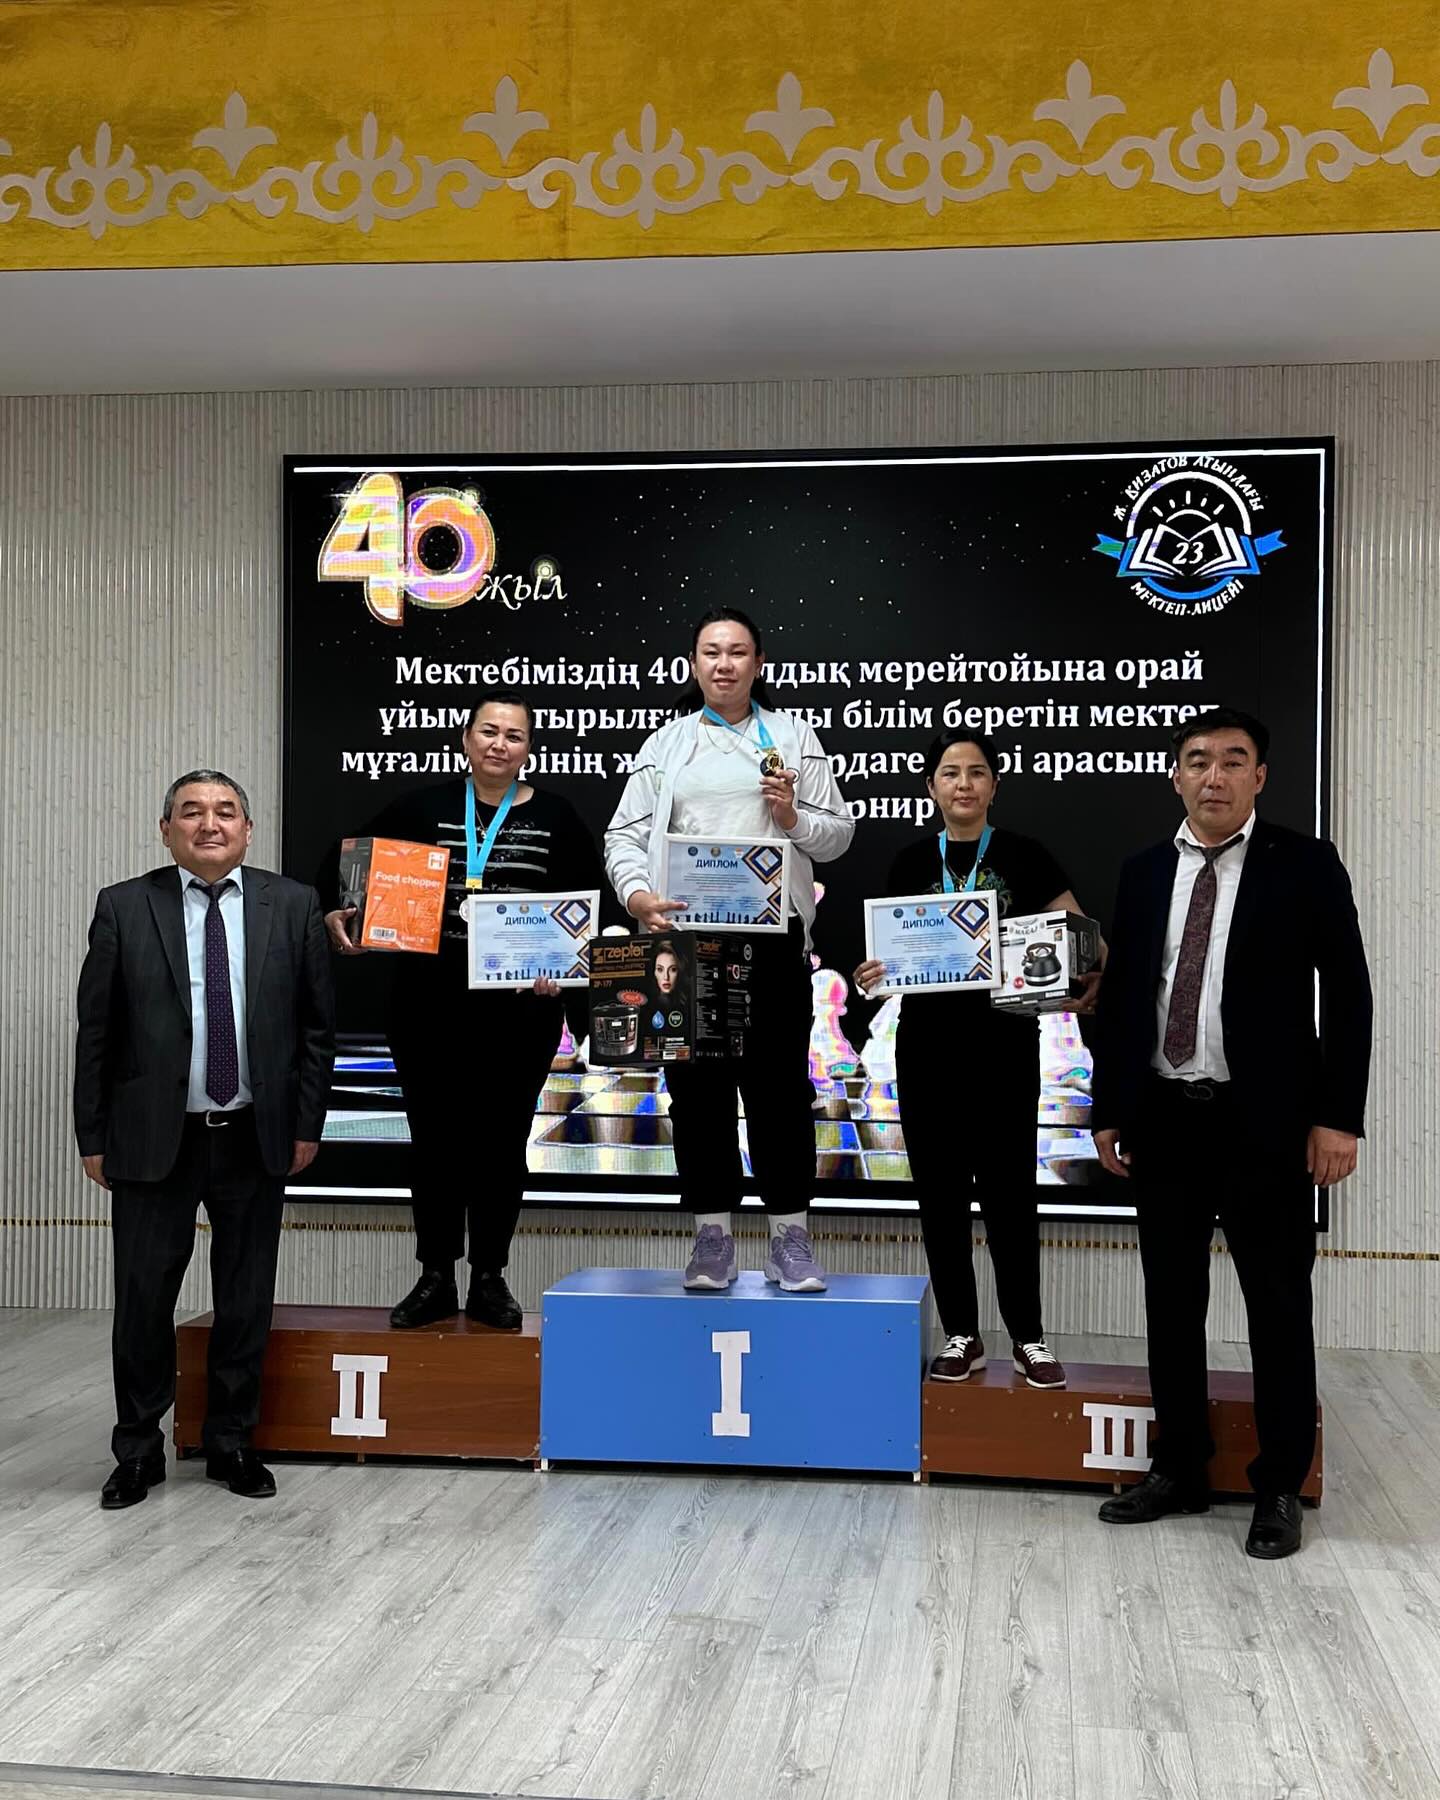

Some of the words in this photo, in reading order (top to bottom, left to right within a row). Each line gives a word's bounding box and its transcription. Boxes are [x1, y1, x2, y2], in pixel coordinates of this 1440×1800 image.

[318, 471, 496, 627] 40
[1172, 541, 1204, 564] 23
[474, 573, 568, 611] жыл
[395, 656, 640, 691] Мектебіміздің
[648, 656, 690, 685] 40
[858, 652, 1106, 691] мерейтойына
[1115, 651, 1204, 689] орай
[842, 699, 933, 729] білім
[942, 698, 1080, 736] беретін
[375, 871, 401, 882] Food
[401, 874, 441, 889] chopper
[695, 859, 738, 869] ДИПЛОМ
[505, 916, 547, 926] ДИПЛОМ
[902, 918, 945, 929] ДИПЛОМ
[331, 1354, 389, 1437] II
[712, 1331, 750, 1437] I
[1082, 1402, 1156, 1472] III
